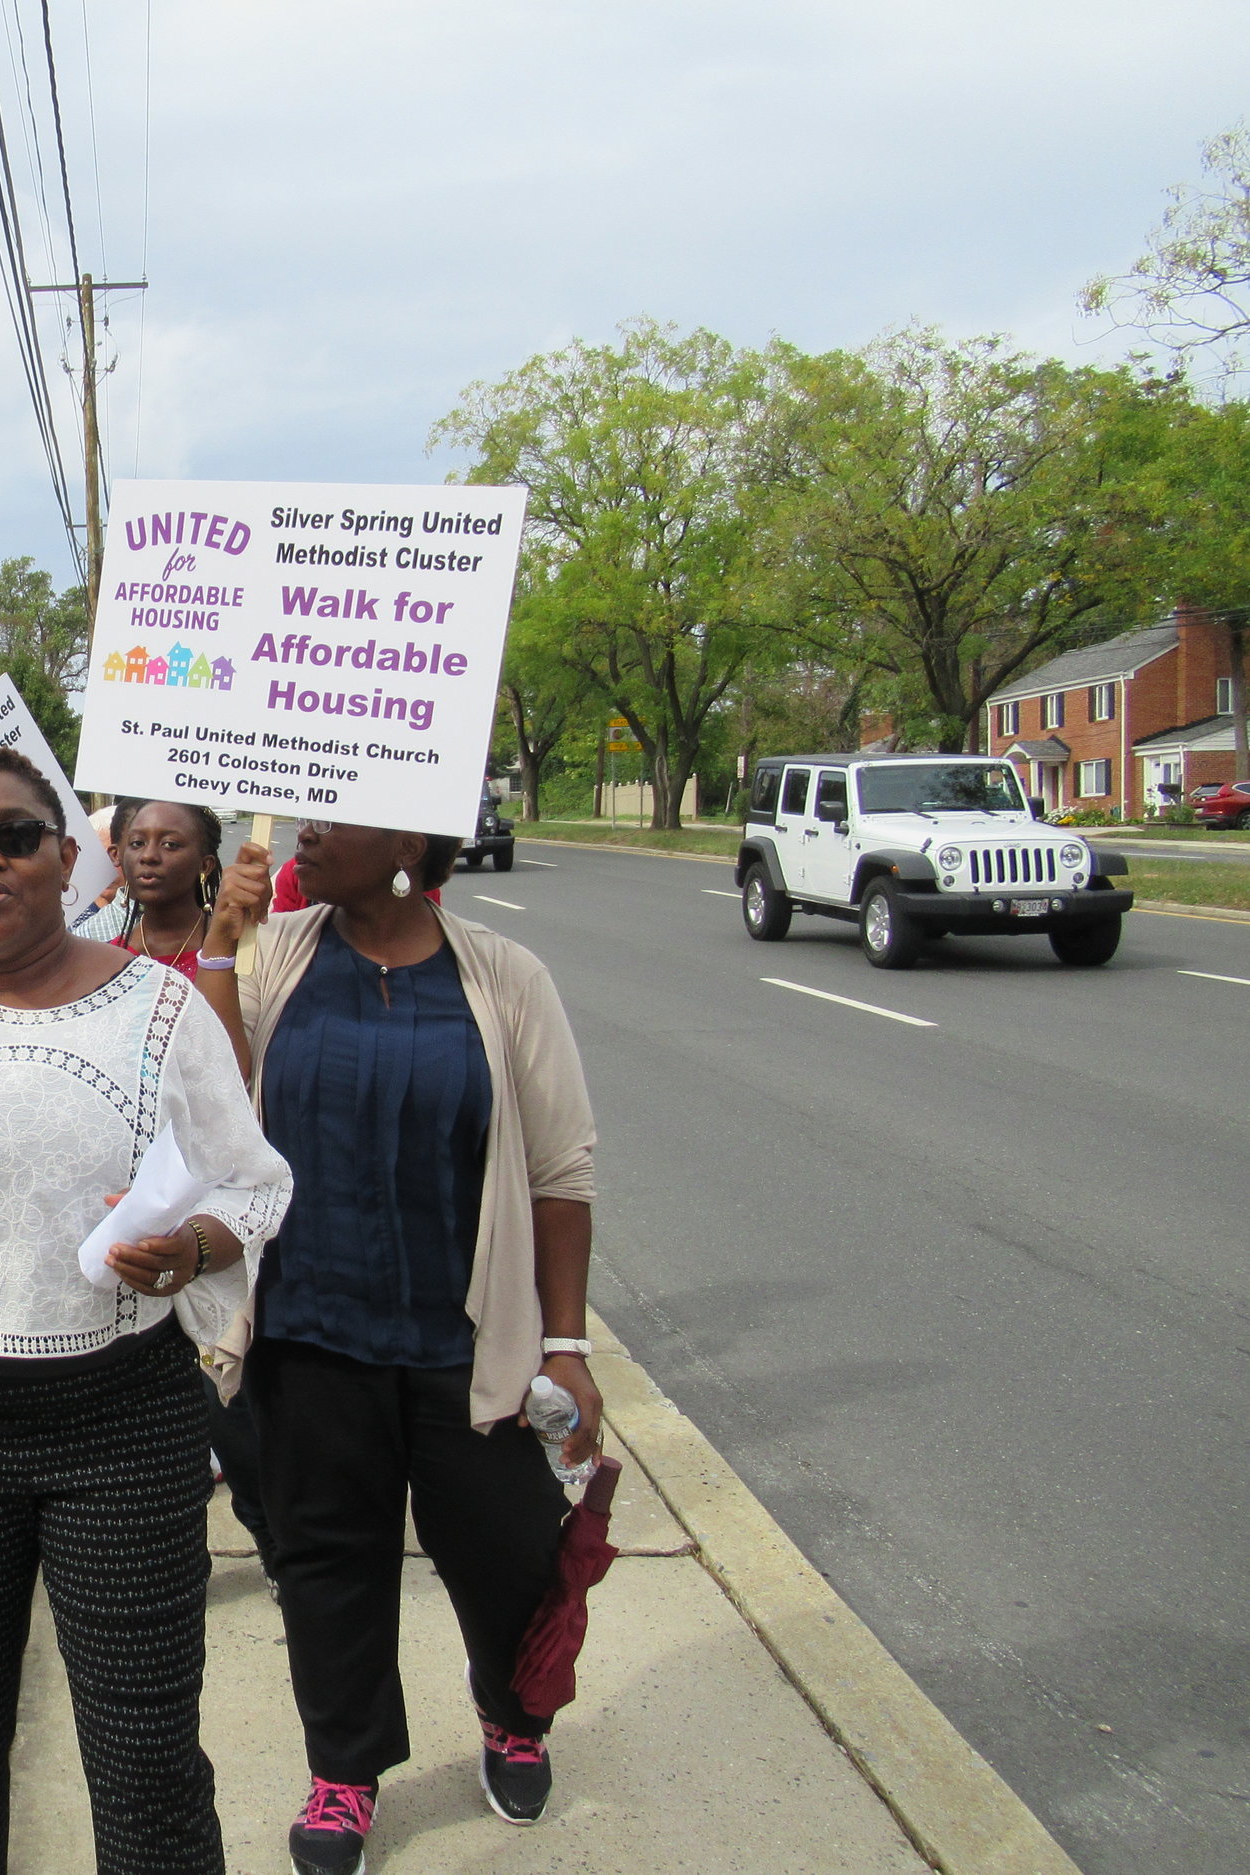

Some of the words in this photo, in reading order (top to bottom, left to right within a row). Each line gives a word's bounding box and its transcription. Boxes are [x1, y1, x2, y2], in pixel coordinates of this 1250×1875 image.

[125, 511, 251, 556] UNITED
[270, 507, 335, 530] Silver
[340, 508, 414, 538] Spring
[422, 511, 503, 536] United
[162, 546, 197, 582] for
[276, 542, 388, 568] Methodist
[395, 547, 483, 572] Cluster
[114, 581, 245, 607] AFFORDABLE
[281, 585, 380, 620] Walk
[393, 591, 455, 624] for
[130, 607, 220, 631] HOUSING
[250, 632, 469, 677] Affordable
[267, 680, 435, 731] Housing
[121, 719, 144, 735] St.
[150, 722, 190, 740] Paul
[195, 726, 256, 746] United
[262, 733, 359, 756] Methodist
[366, 742, 440, 765] Church
[167, 748, 211, 766] 2601
[217, 753, 301, 776] Coloston
[307, 762, 359, 782] Drive
[174, 773, 231, 795] Chevy
[236, 780, 300, 803] Chase,
[307, 788, 339, 804] MD
